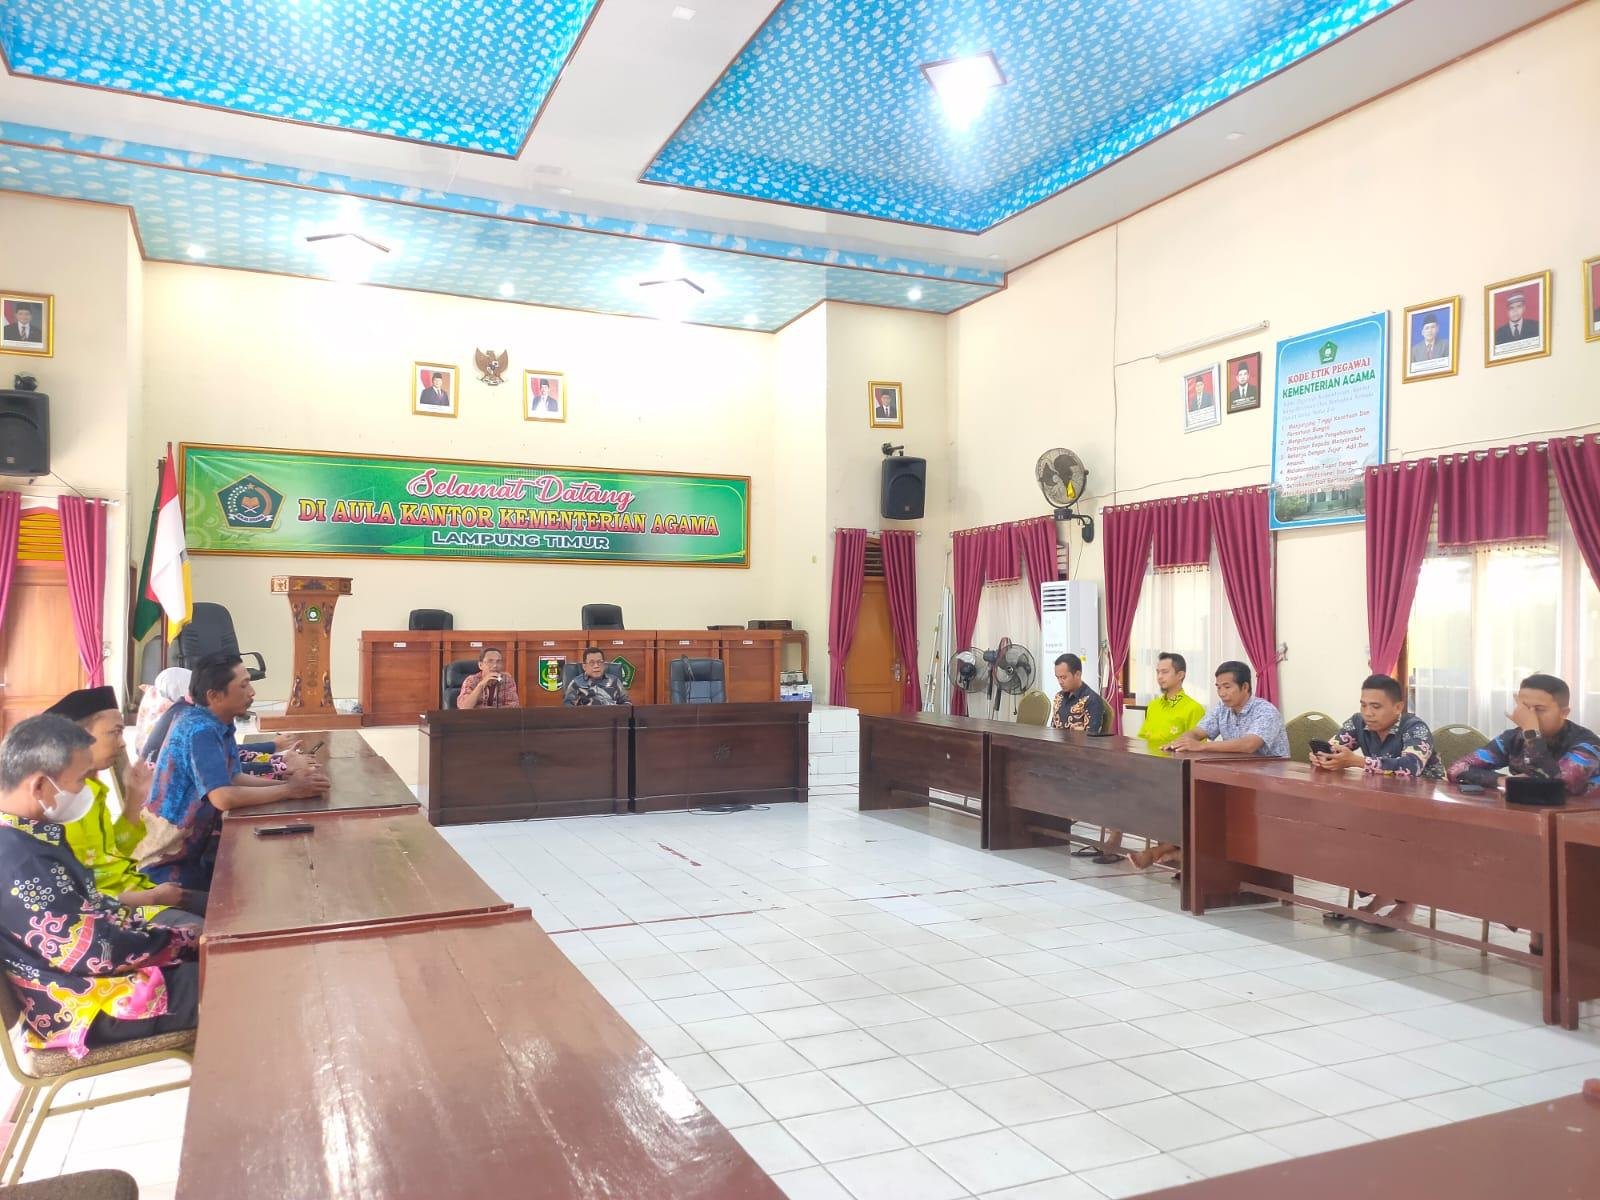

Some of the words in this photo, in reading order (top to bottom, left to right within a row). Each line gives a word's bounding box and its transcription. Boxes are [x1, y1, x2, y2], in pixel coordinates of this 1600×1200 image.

[1282, 377, 1340, 399] KEMENTERIAN
[1342, 369, 1376, 386] AGAMA
[1288, 371, 1309, 384] KODE
[1311, 367, 1330, 379] ETIK
[1332, 358, 1371, 374] PEGAWAI
[406, 468, 529, 500] Selamat
[536, 475, 635, 512] Datang
[298, 498, 327, 522] DI
[331, 500, 395, 525] AULA
[399, 502, 494, 529] KANTOR
[498, 507, 647, 534] KEMENTERIAN
[651, 513, 720, 536] AGAMA
[432, 530, 539, 547] LAMPUNG
[543, 534, 610, 549] TIMUR
